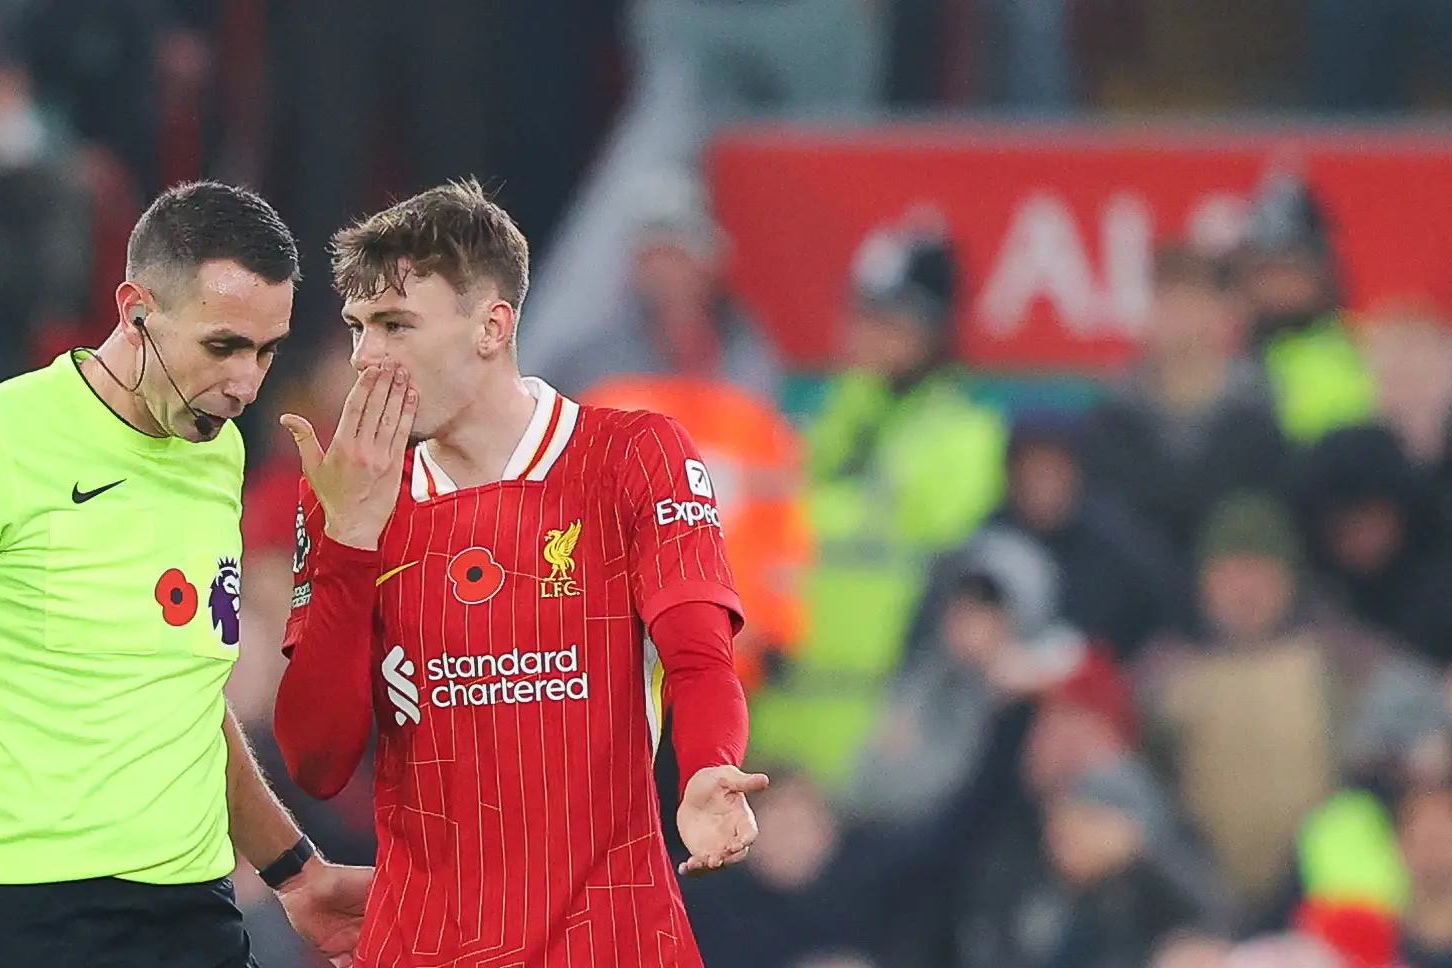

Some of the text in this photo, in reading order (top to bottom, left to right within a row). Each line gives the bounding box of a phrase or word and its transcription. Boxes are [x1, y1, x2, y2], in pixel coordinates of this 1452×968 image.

[540, 581, 581, 598] L.F.C.
[427, 644, 578, 681] standard
[431, 672, 589, 708] chartered
